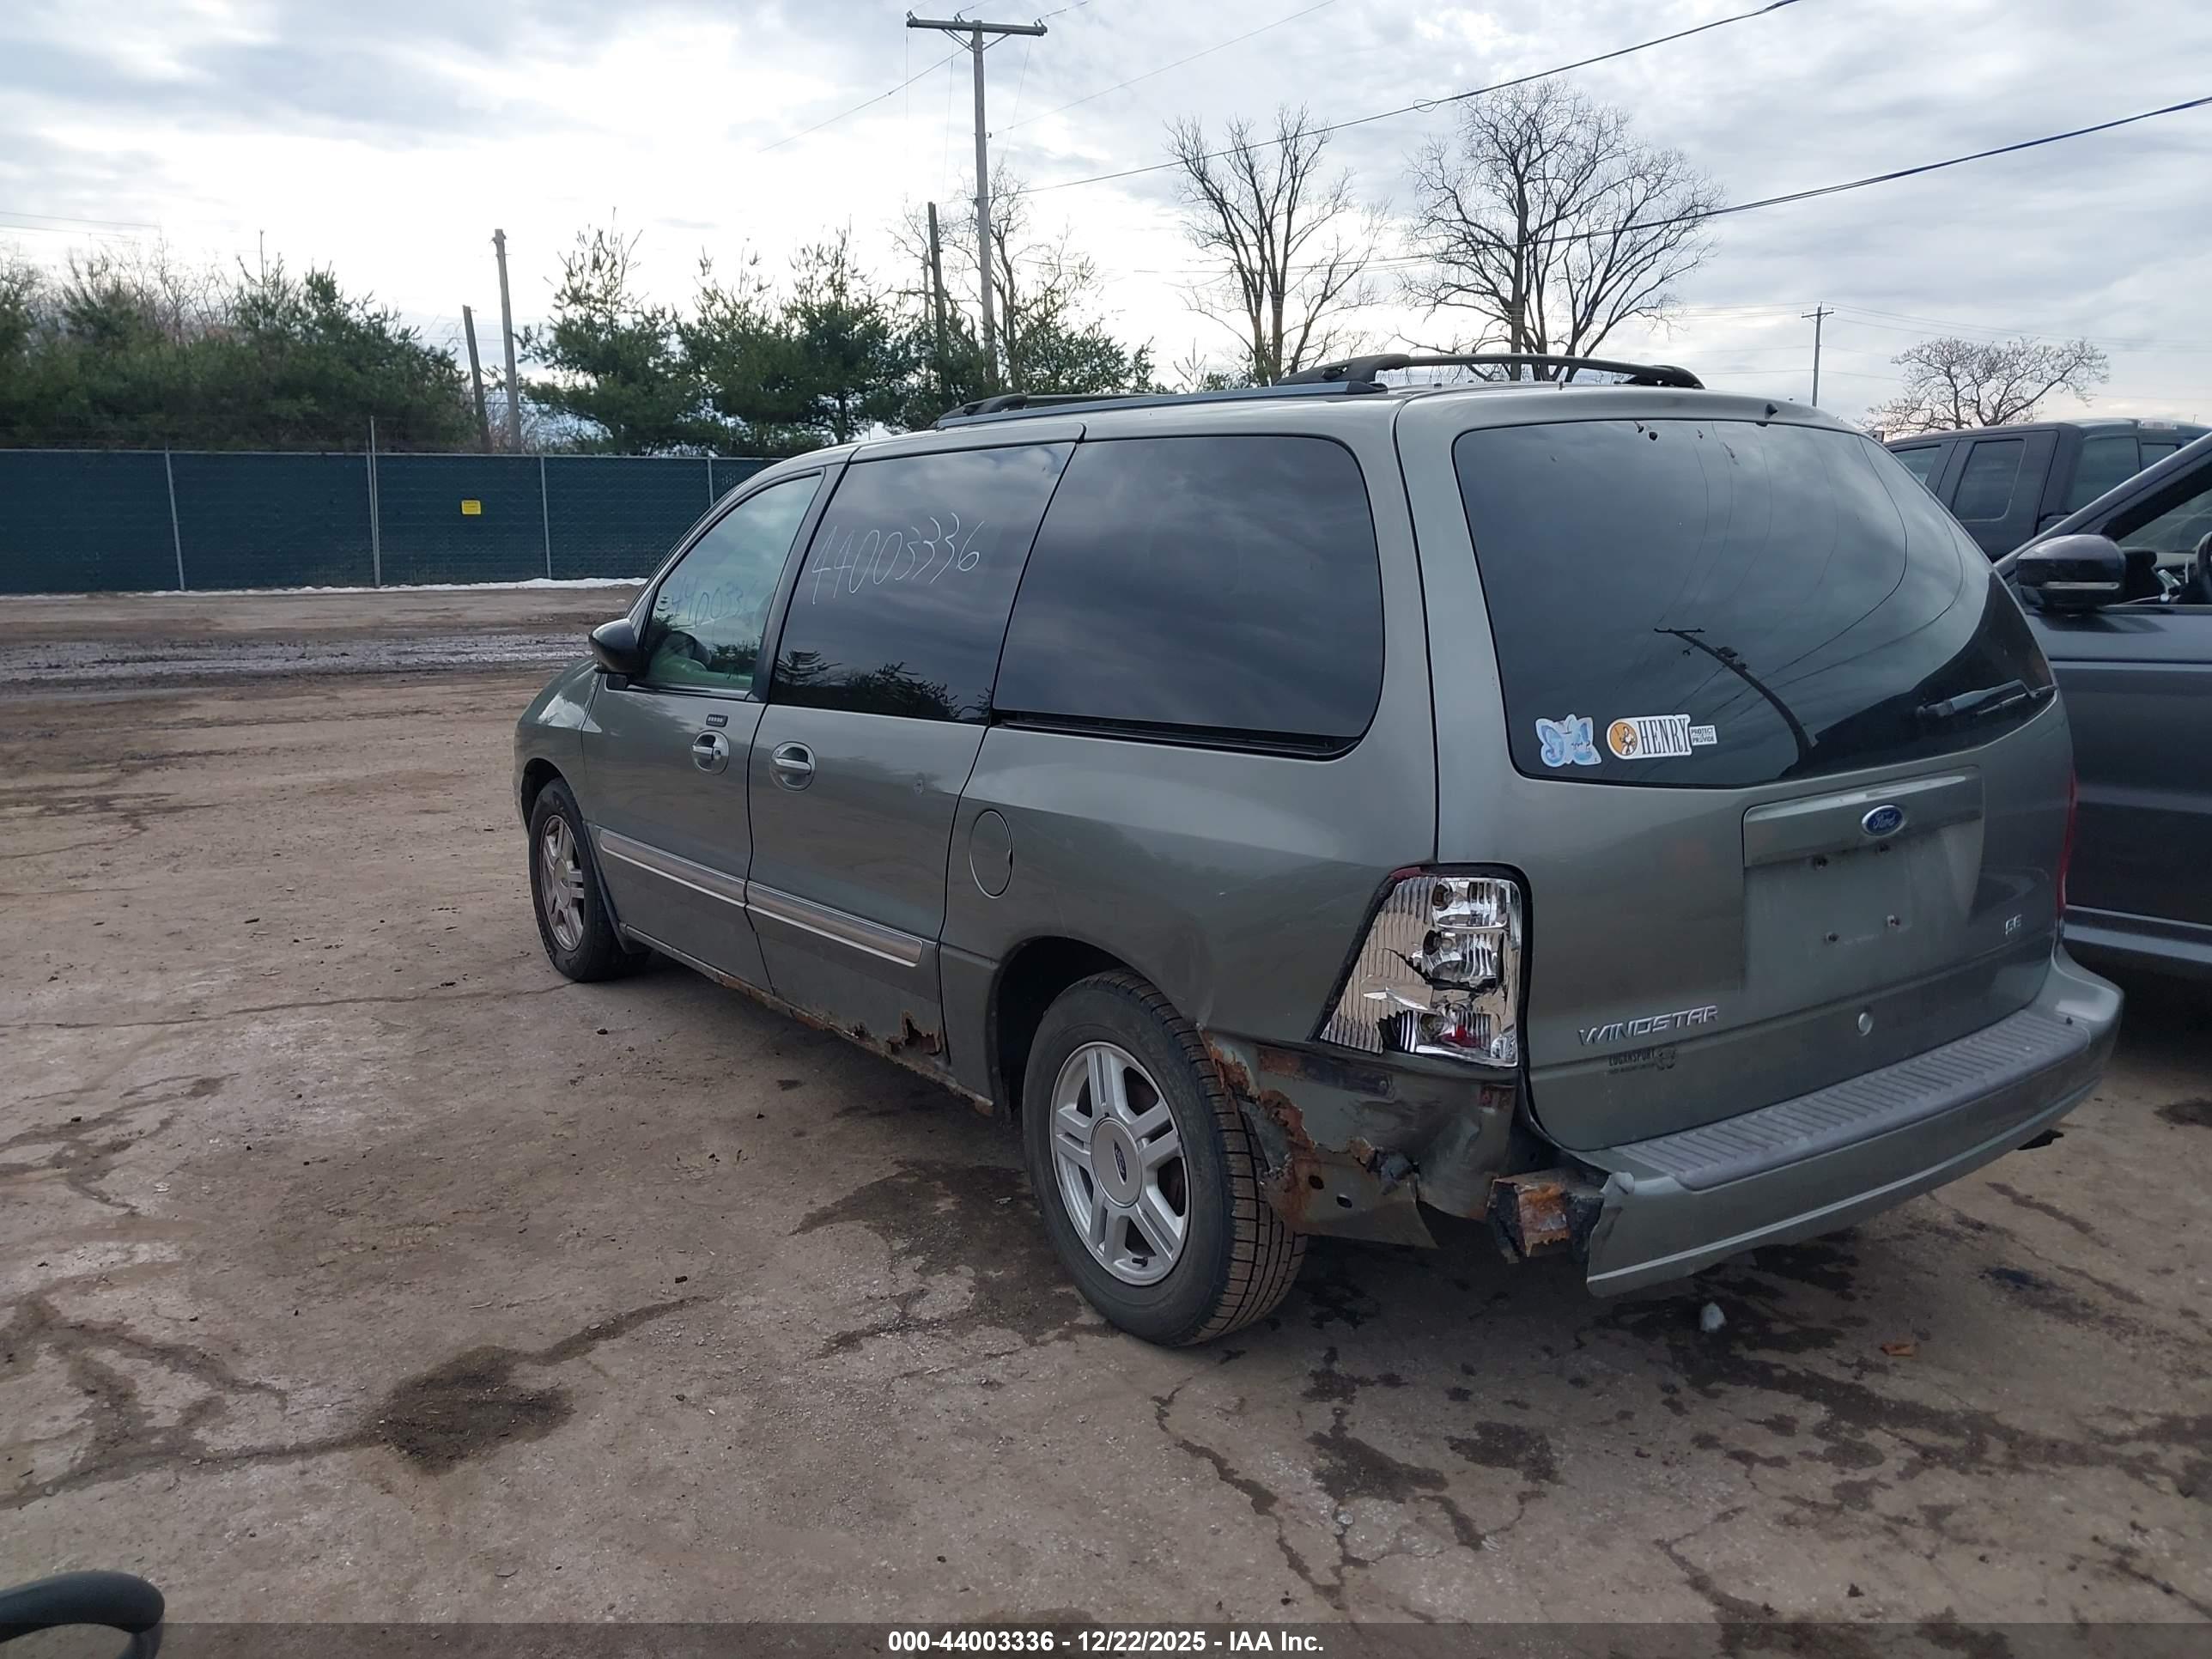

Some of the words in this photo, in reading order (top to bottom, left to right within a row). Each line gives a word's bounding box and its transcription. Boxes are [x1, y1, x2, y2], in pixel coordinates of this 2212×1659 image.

[811, 513, 986, 605] 44003336
[1637, 718, 1692, 756] HENRY
[1577, 1005, 1719, 1045] WINDSTAR
